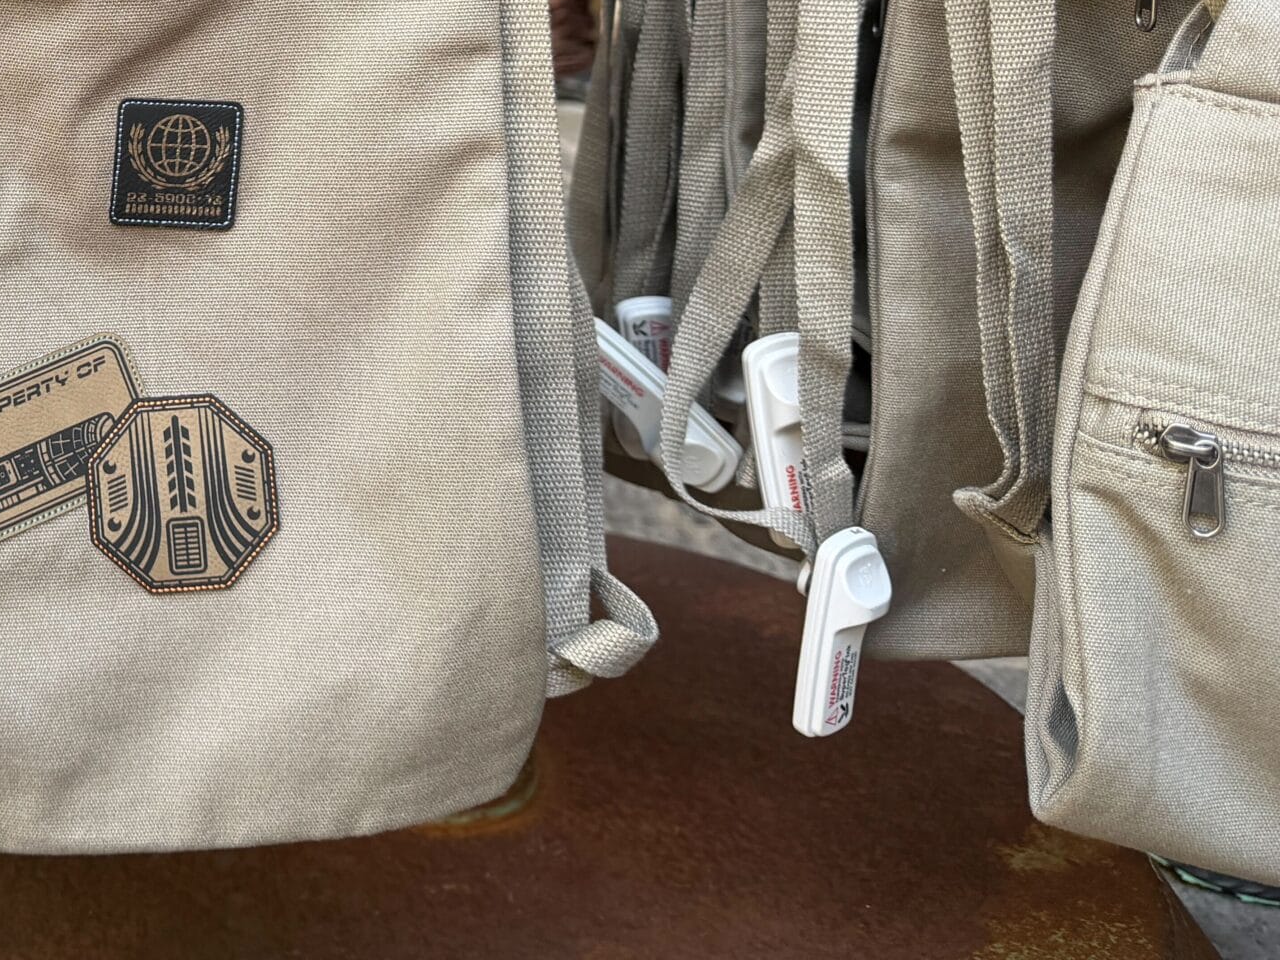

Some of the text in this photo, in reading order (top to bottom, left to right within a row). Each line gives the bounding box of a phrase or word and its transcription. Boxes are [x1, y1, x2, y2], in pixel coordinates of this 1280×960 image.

[76, 355, 106, 379] OF
[786, 465, 802, 513] ARNING
[829, 651, 842, 708] WARNING
